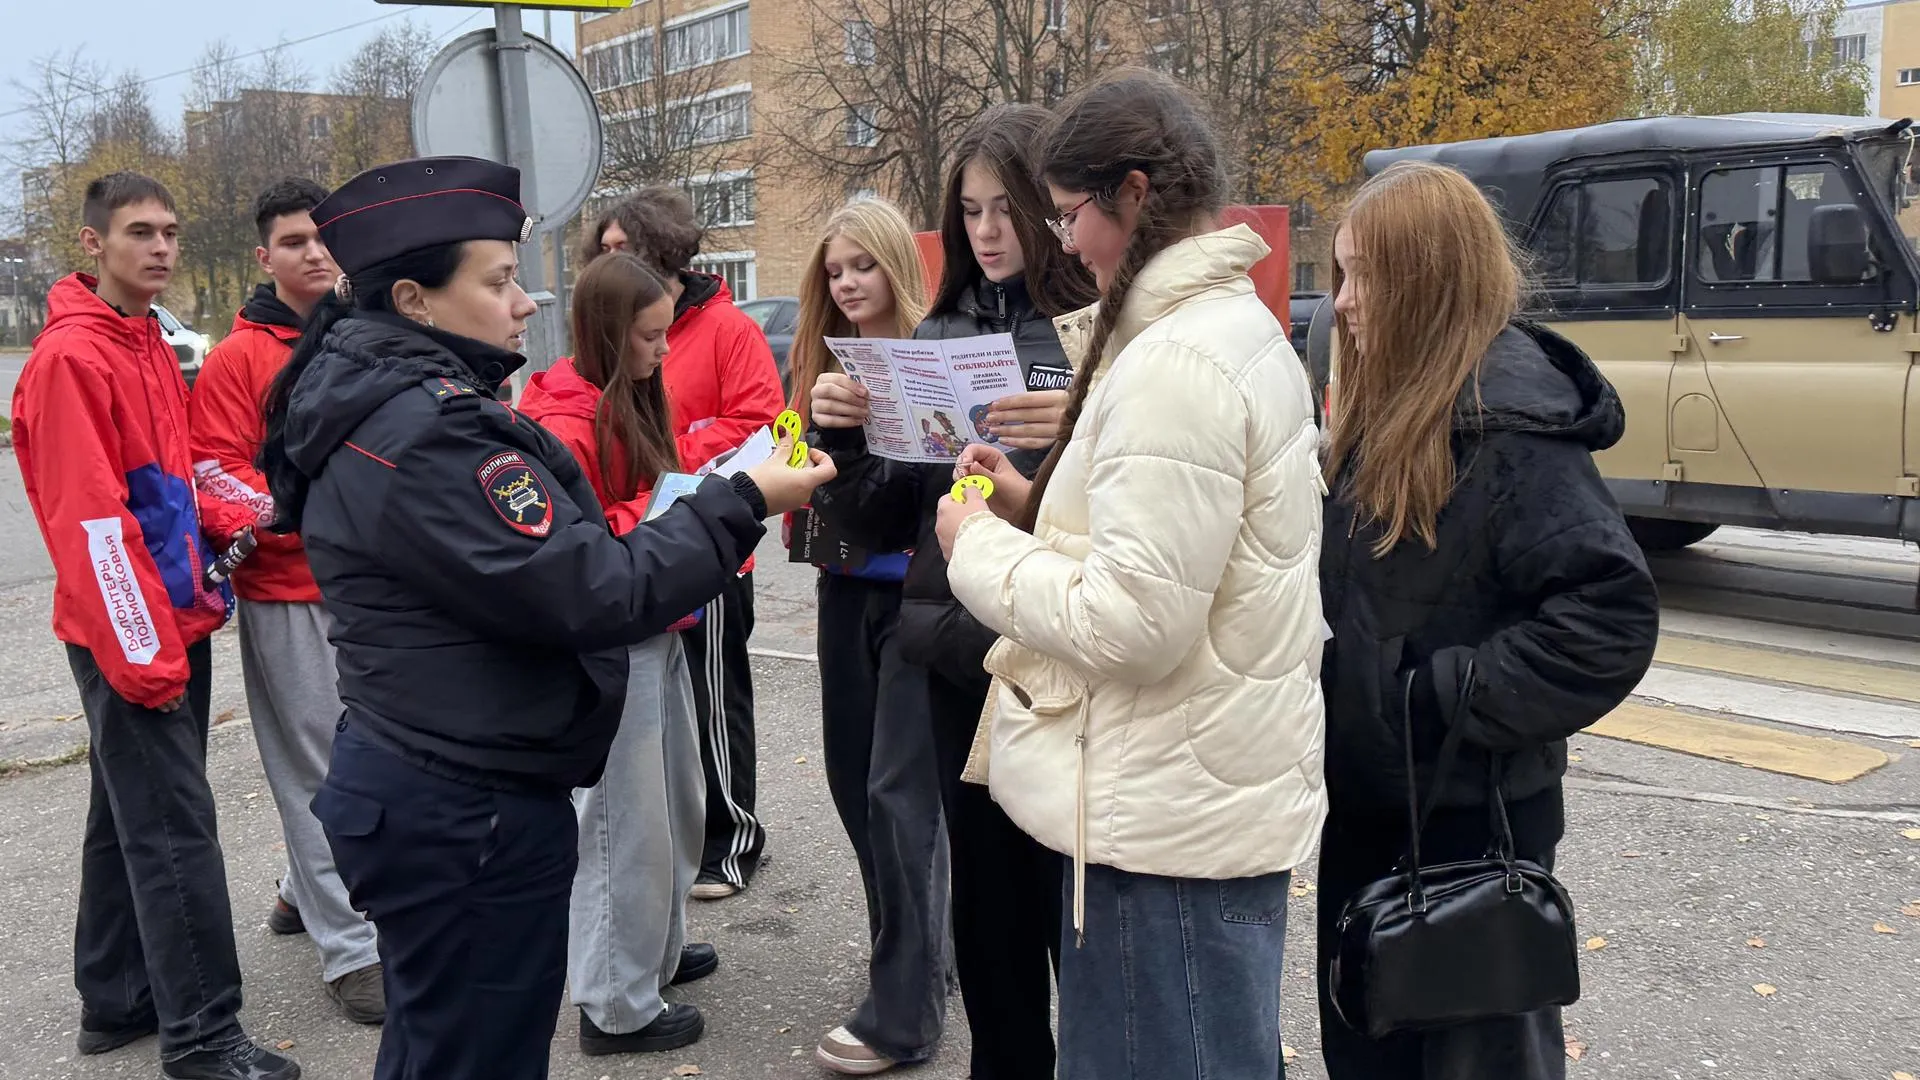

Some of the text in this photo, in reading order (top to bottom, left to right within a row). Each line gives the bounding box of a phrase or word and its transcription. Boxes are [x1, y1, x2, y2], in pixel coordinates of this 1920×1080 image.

[951, 351, 985, 360] РОДИТЕЛИ
[970, 377, 1008, 386] ДОРОЖНОГО
[480, 454, 520, 480] ПОЛИЦИЯ
[530, 518, 550, 533] МВД
[105, 534, 153, 648] ПОДМОСКОВЬЯ
[98, 559, 140, 652] ВОЛОНТЕРЫ
